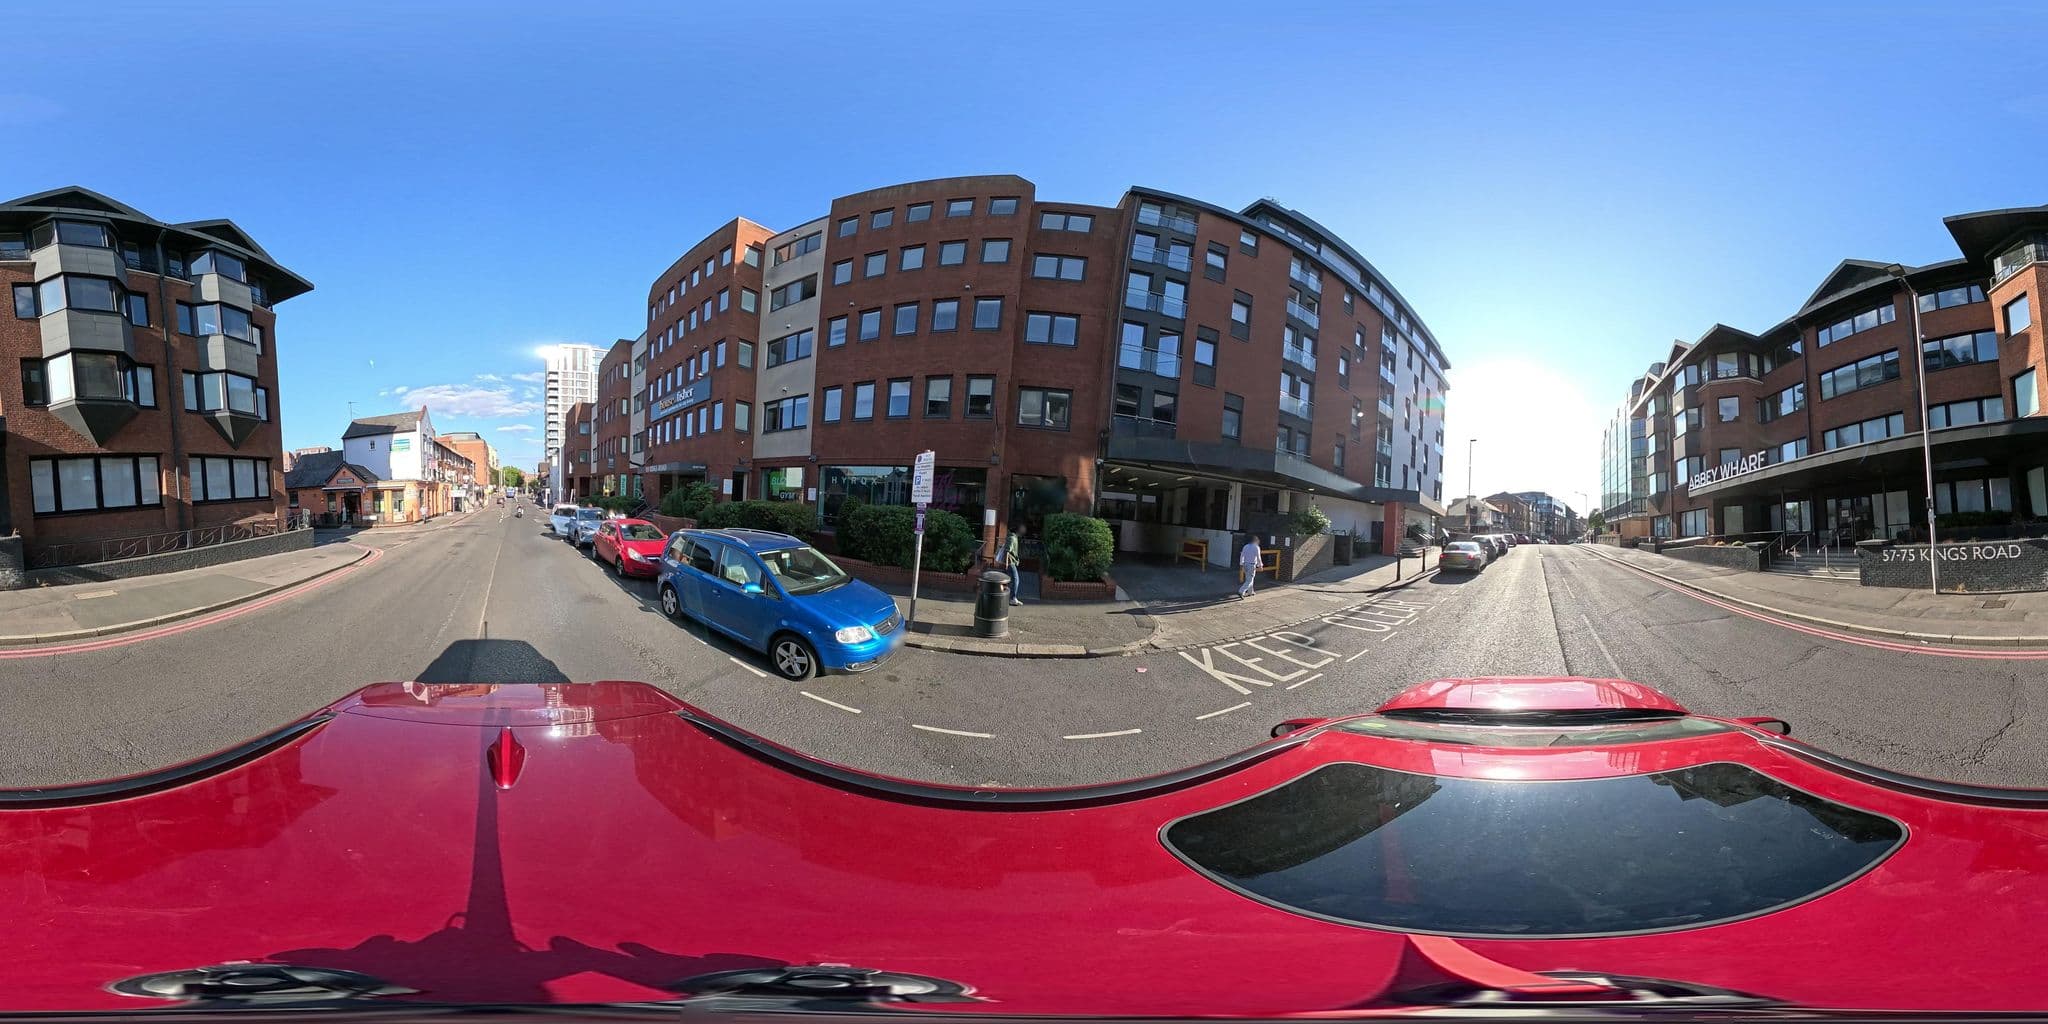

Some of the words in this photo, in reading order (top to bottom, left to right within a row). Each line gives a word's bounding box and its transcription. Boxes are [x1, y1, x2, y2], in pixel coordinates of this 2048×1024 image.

[1688, 466, 1718, 490] ABBEY
[1720, 450, 1766, 480] WHARF
[1882, 549, 1915, 562] 57-75
[1920, 546, 1967, 561] KNGS
[1973, 544, 2021, 560] ROAD
[1178, 631, 1342, 695] KEEP
[1322, 599, 1431, 632] CLEAR
